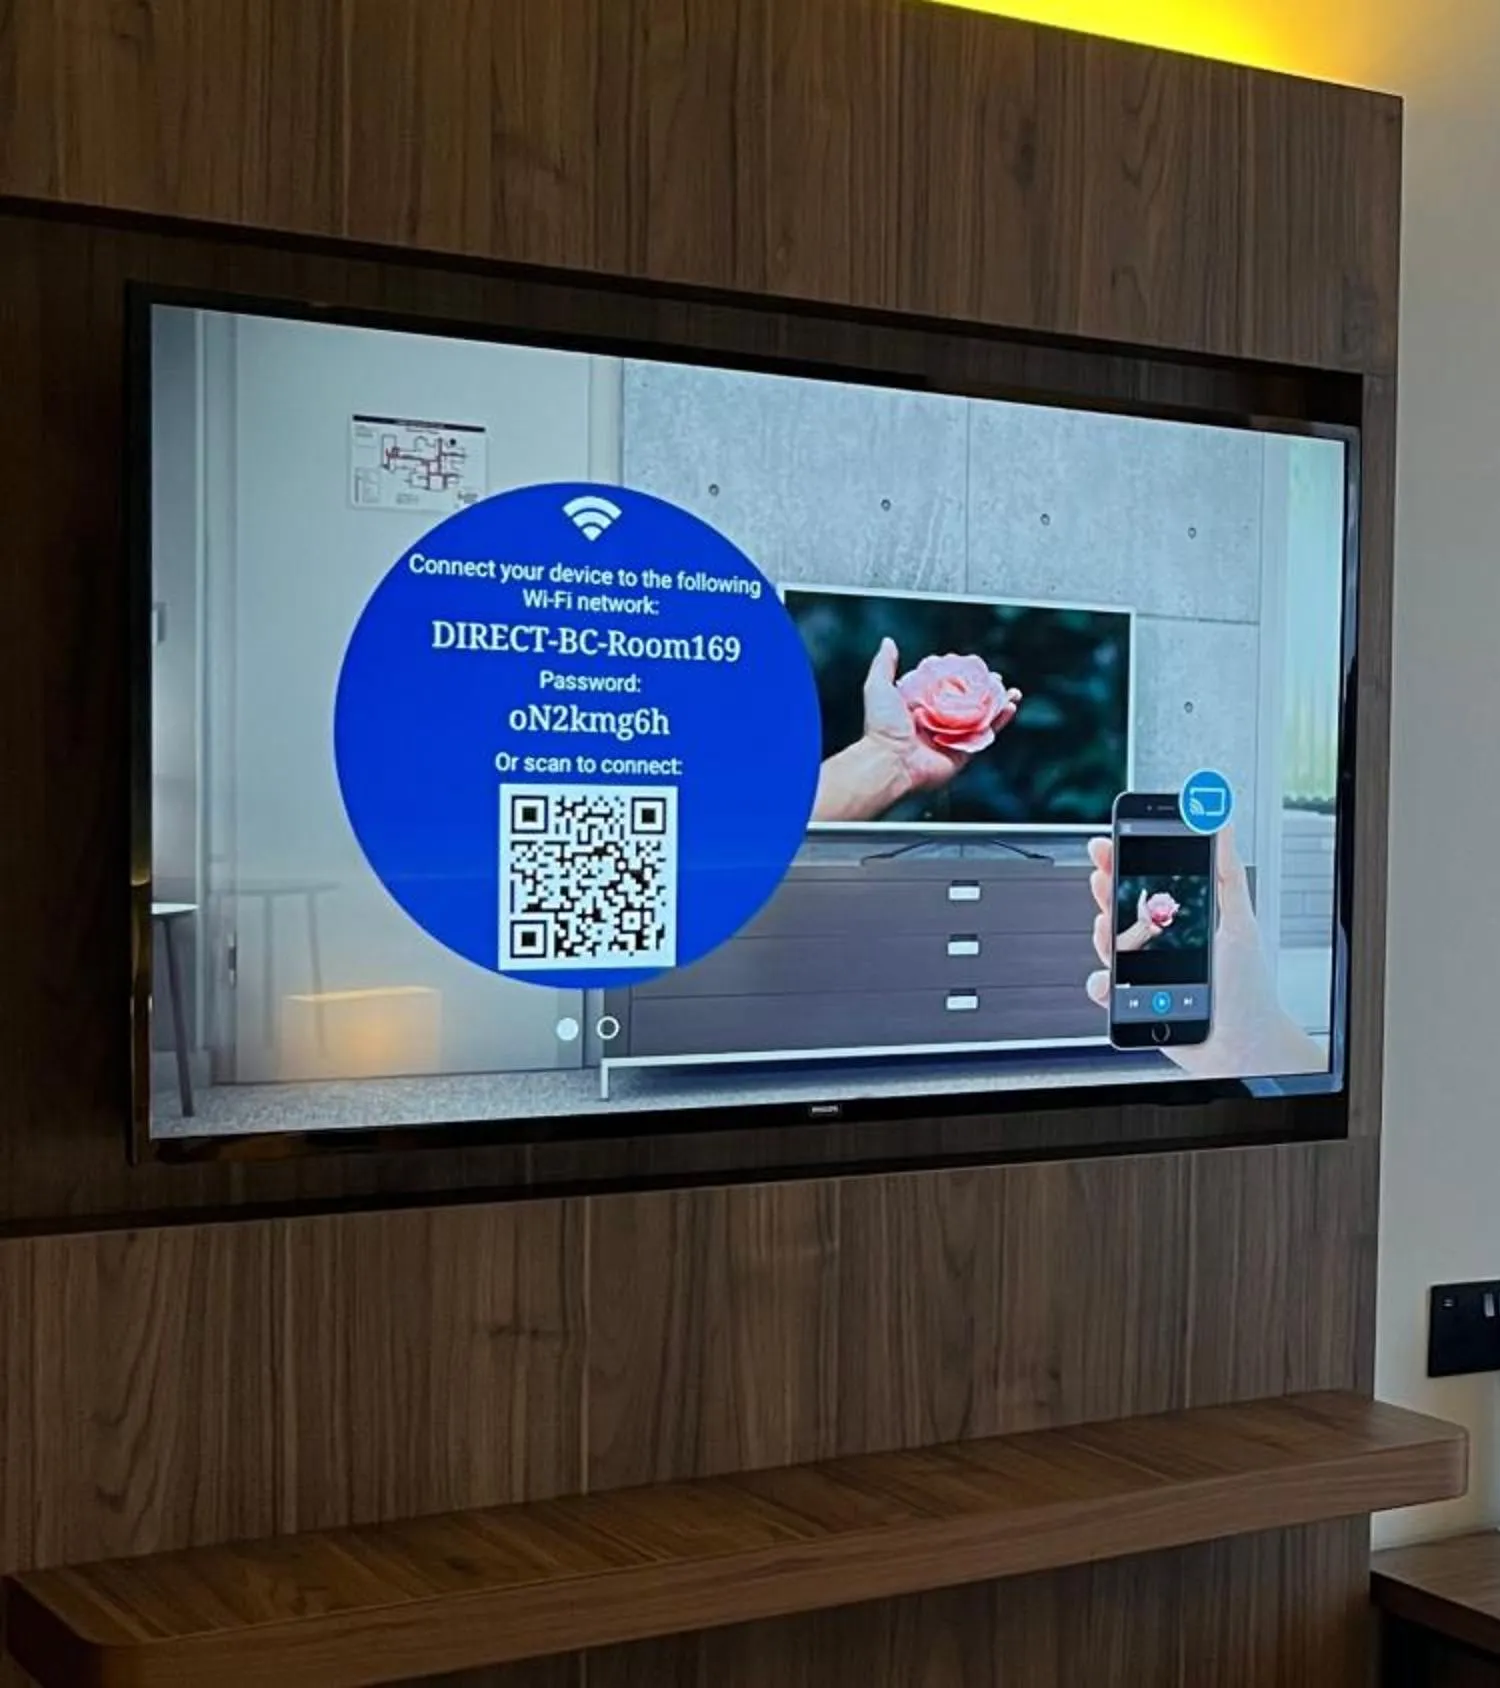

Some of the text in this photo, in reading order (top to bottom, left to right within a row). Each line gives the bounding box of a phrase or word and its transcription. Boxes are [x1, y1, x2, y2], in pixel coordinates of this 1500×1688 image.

[409, 553, 761, 599] Connect your device to the following
[522, 588, 660, 615] Wi-Fi network:
[431, 620, 742, 662] DIRECT-BC-Room169
[539, 670, 642, 693] Password:
[508, 704, 671, 741] oN2kmg6h
[495, 751, 683, 775] Or scan to connect:
